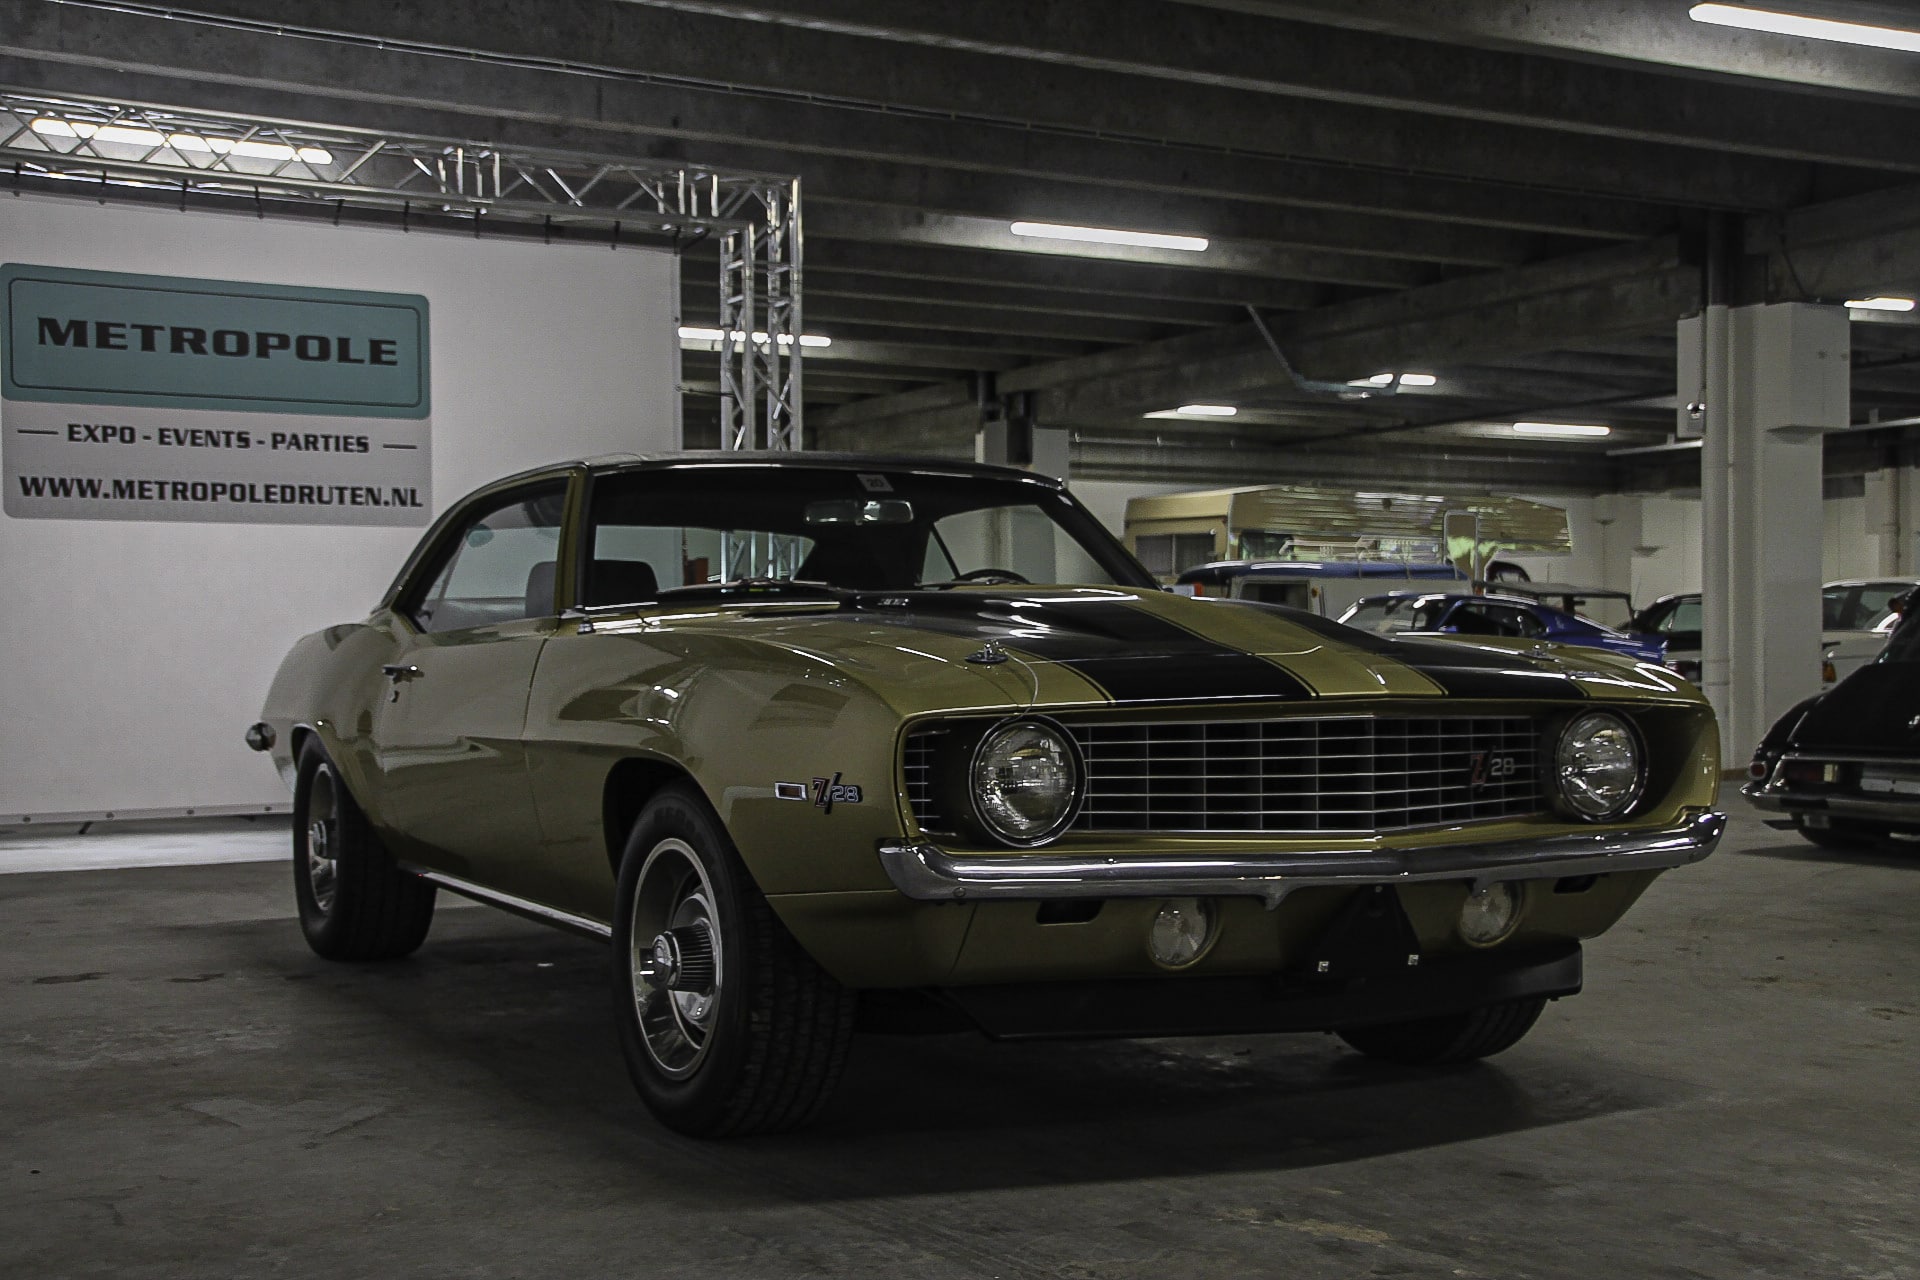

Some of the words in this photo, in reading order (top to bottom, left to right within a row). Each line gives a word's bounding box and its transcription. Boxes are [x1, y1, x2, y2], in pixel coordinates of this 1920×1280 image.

[37, 317, 399, 366] METROPOLE
[67, 423, 136, 445] EXPO
[158, 428, 250, 450] EVENTS
[271, 432, 370, 454] PARTIES
[19, 476, 423, 508] WWW.METROPOLEDRUTEN.NL
